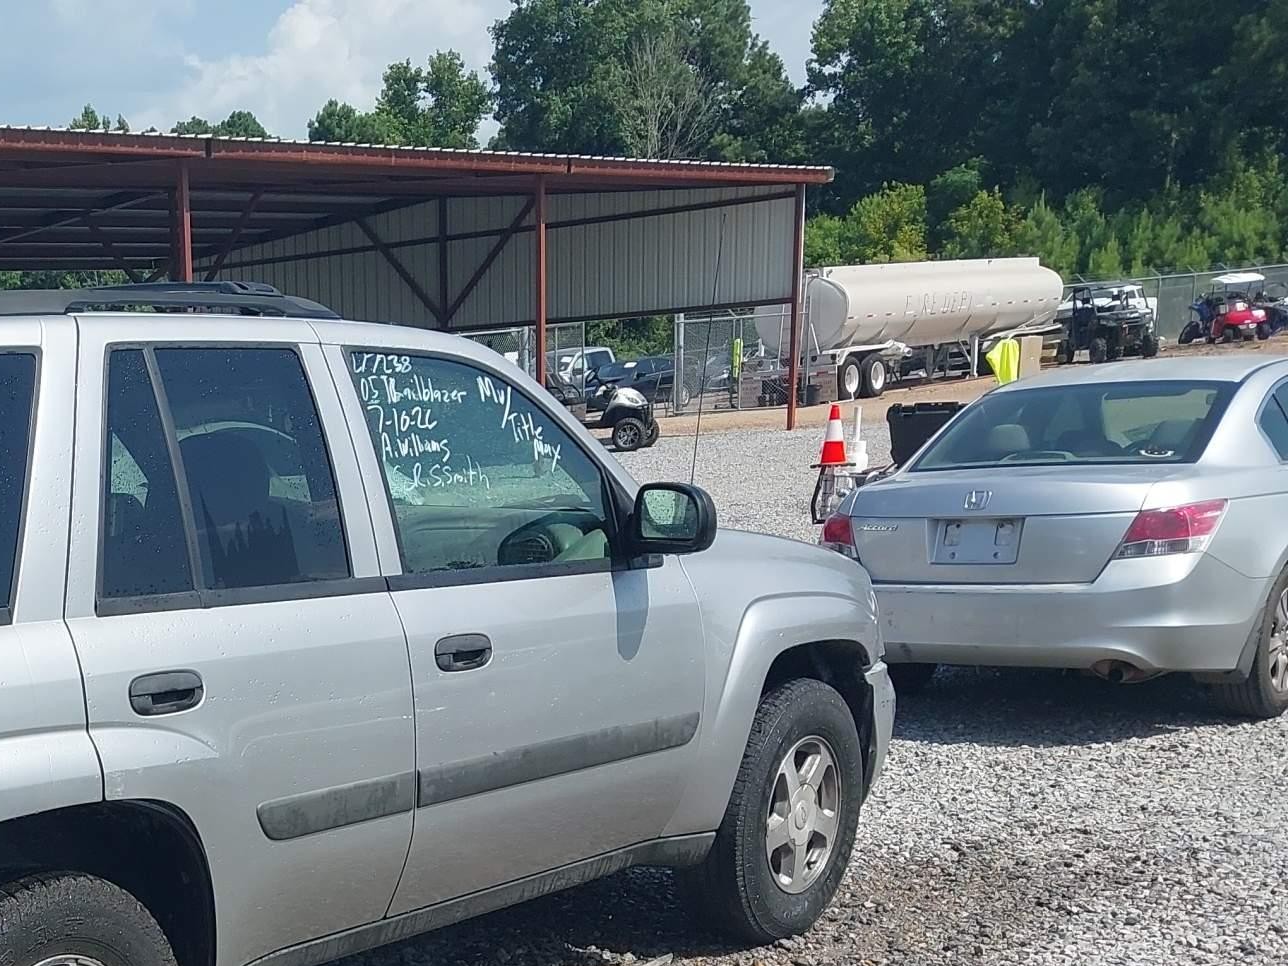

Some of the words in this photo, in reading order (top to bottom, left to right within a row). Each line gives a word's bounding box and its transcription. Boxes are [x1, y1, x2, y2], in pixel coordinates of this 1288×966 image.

[904, 291, 937, 317] FRE
[360, 376, 380, 404] 05
[508, 412, 544, 443] Title
[857, 523, 899, 532] Accord
